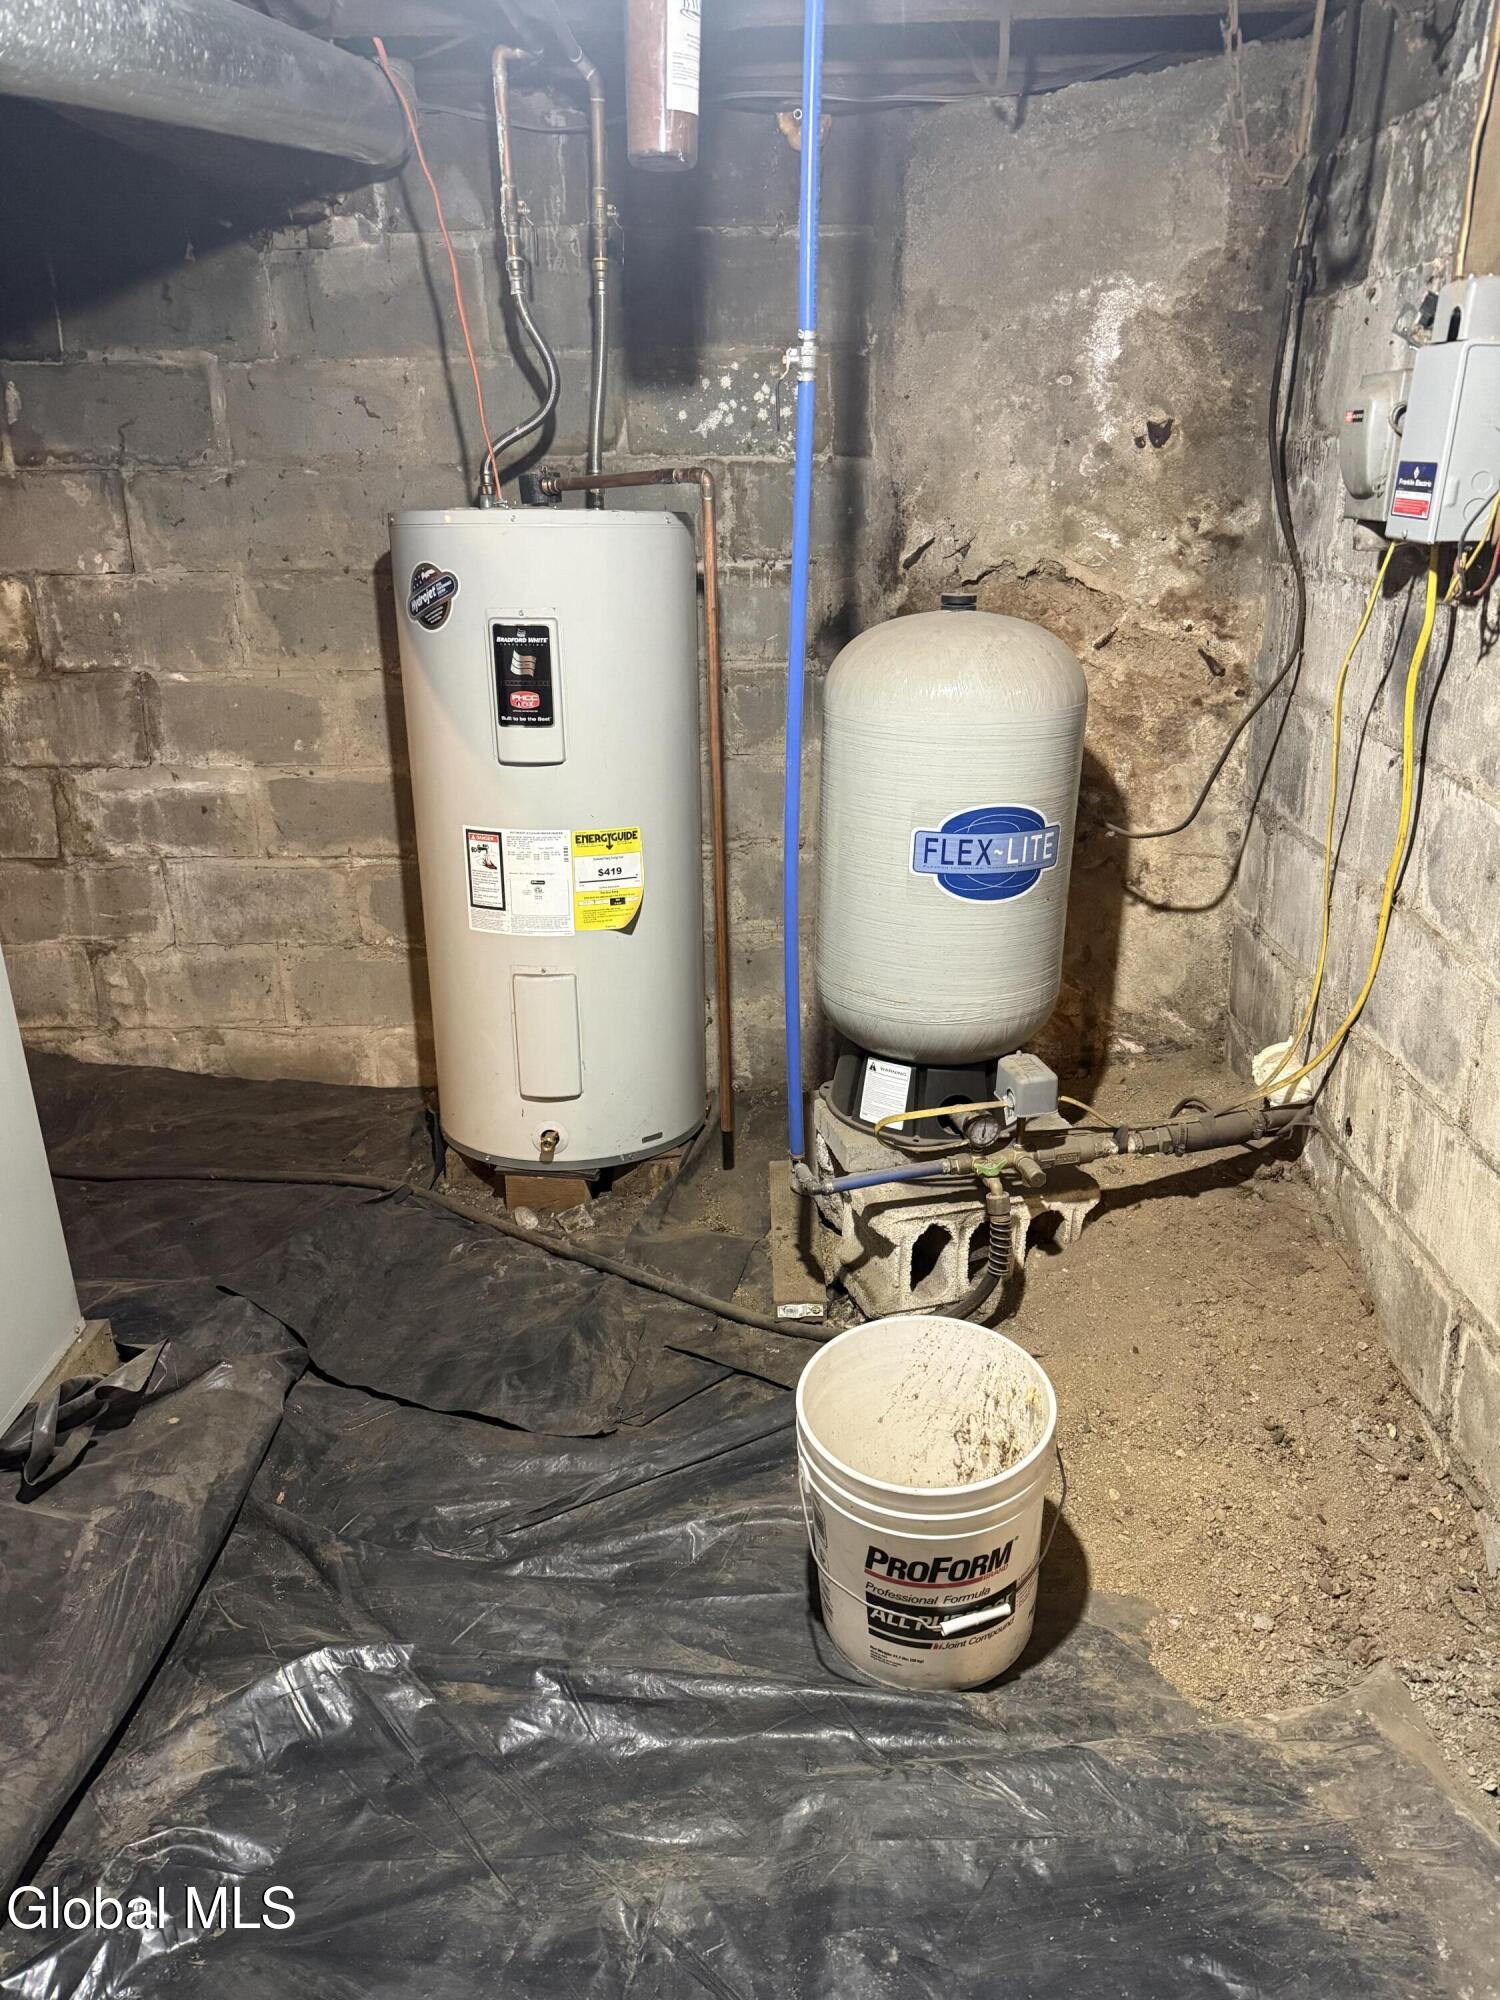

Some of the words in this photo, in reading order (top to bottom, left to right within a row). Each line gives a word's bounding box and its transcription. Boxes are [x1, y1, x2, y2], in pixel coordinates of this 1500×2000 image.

[598, 867, 622, 877] $419
[865, 1581, 938, 1605] Professional
[943, 1587, 991, 1605] Formula
[869, 1608, 911, 1630] ALL
[941, 1639, 966, 1650] Joint
[968, 1617, 1015, 1647] Compound
